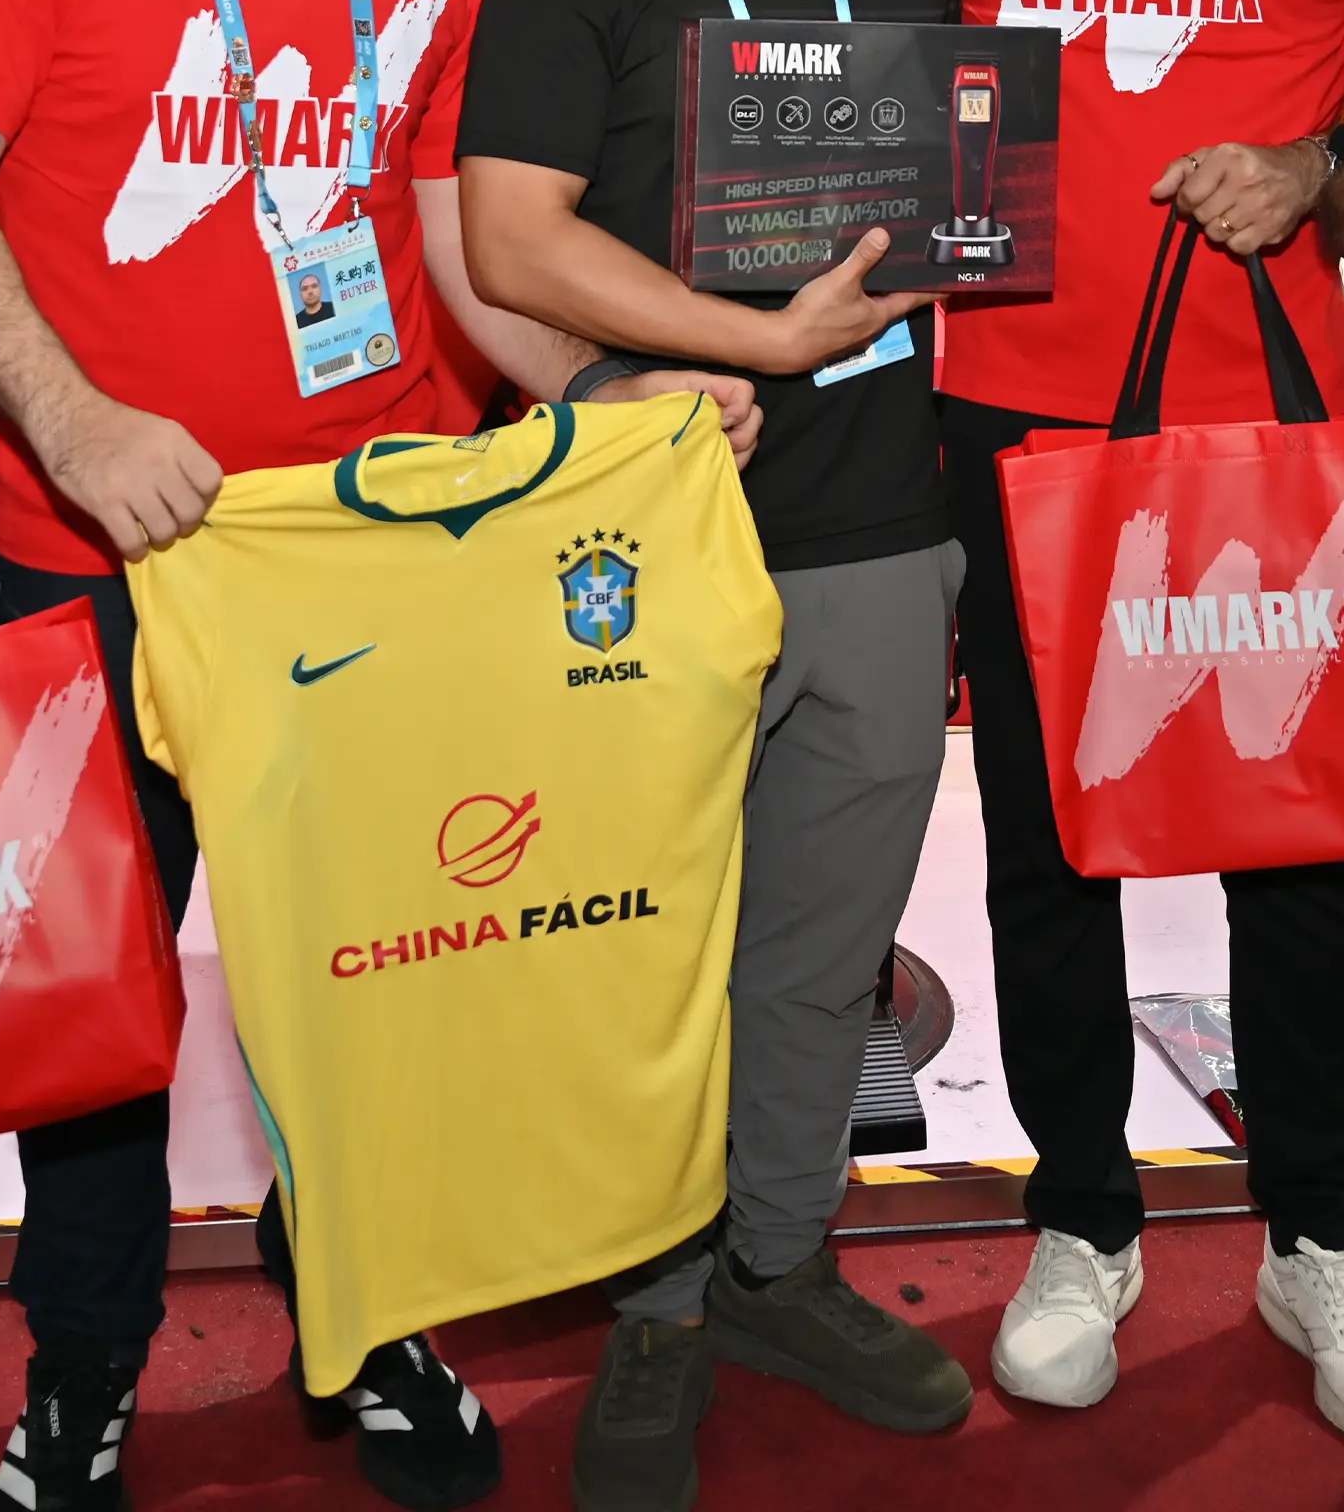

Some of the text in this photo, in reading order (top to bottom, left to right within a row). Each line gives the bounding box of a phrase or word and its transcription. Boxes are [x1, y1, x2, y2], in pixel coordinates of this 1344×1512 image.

[731, 41, 843, 75] WMARK
[734, 74, 842, 82] PROFESSIONAL
[963, 71, 989, 80] WMARK
[736, 111, 757, 119] DLC
[725, 167, 919, 199] HIGH SPEED HAIR CLIPPER
[725, 205, 840, 235] W-MAGLEV
[725, 241, 801, 273] 10,000
[801, 249, 832, 263] RPM
[335, 259, 377, 287] 采购商
[957, 272, 986, 283] NG-X1
[340, 279, 378, 302] BUYER
[585, 590, 616, 607] CBF
[1112, 588, 1340, 657] WMARK
[567, 661, 649, 688] BRASIL
[1126, 652, 1342, 671] PROFESSIONAL
[331, 886, 660, 979] CHINA FÁCIL
